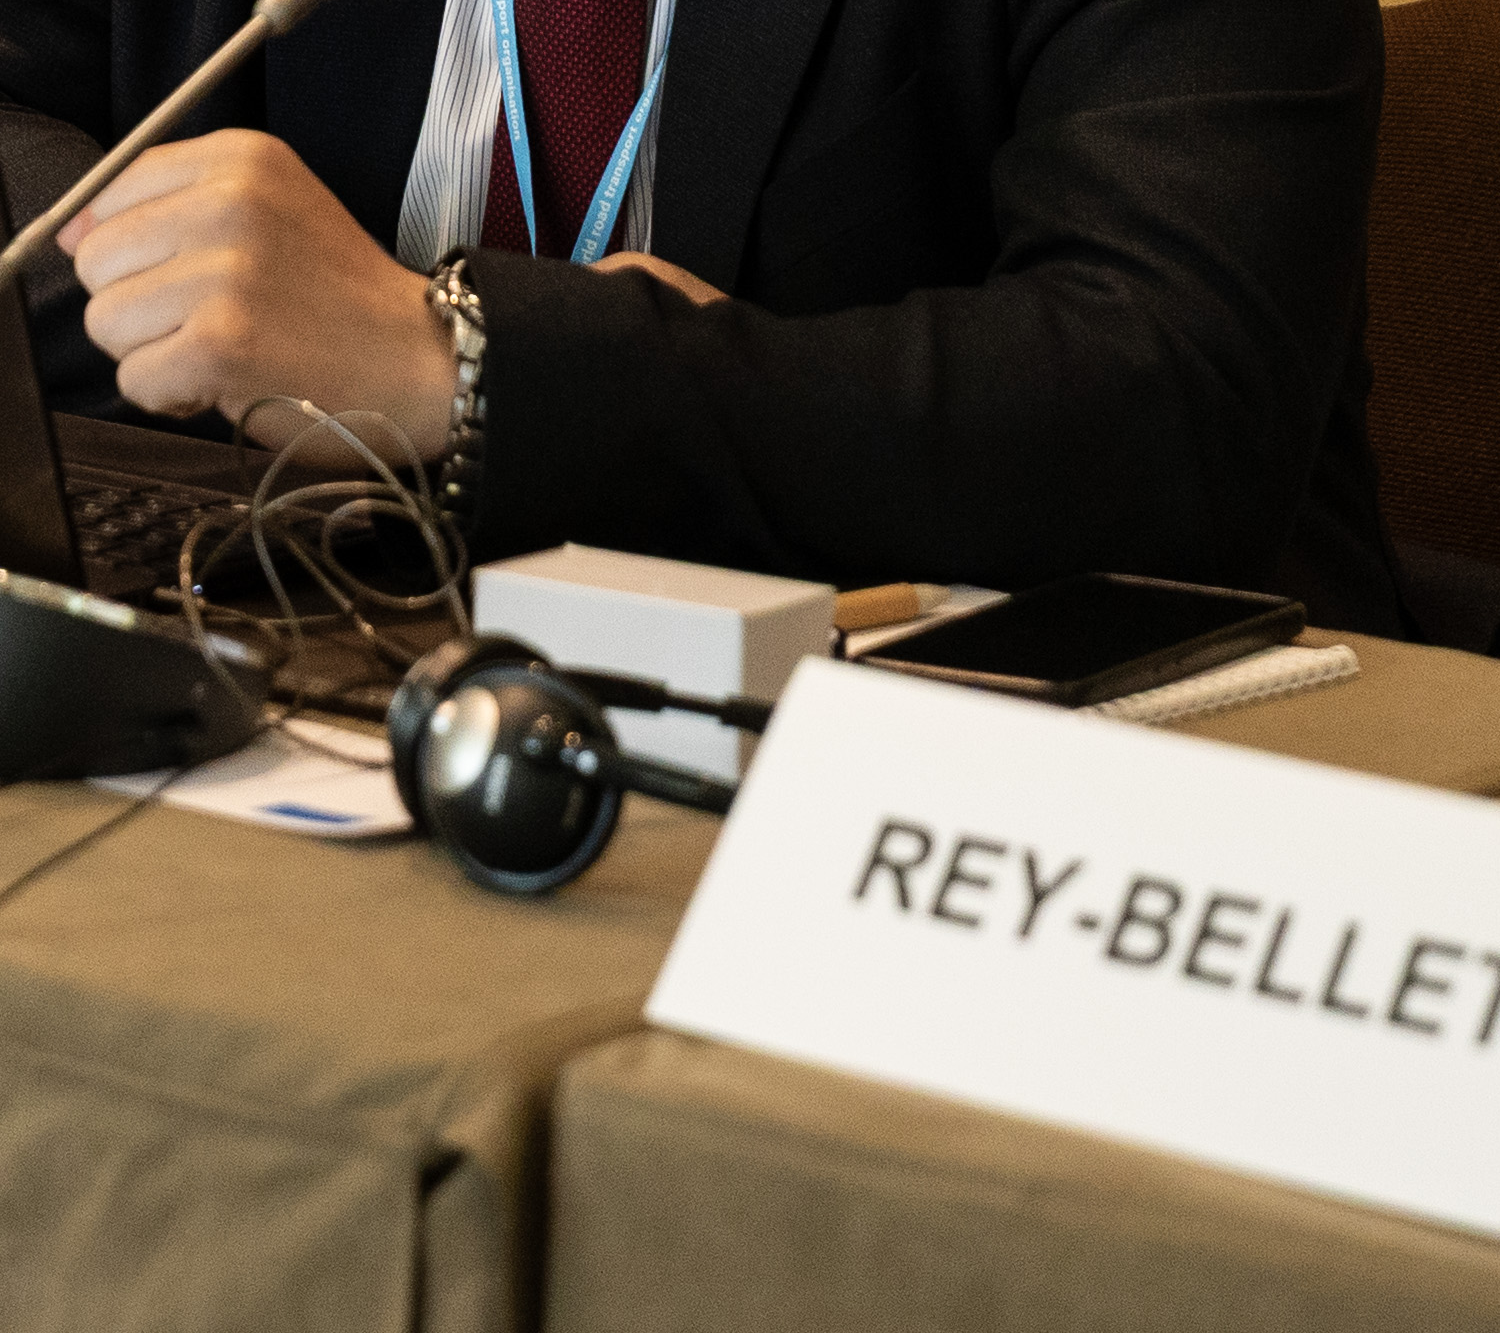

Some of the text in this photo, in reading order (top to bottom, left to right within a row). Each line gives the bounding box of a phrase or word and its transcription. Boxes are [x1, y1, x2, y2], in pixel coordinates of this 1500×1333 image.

[501, 39, 521, 142] organisation
[591, 199, 612, 236] road
[603, 124, 639, 199] transport
